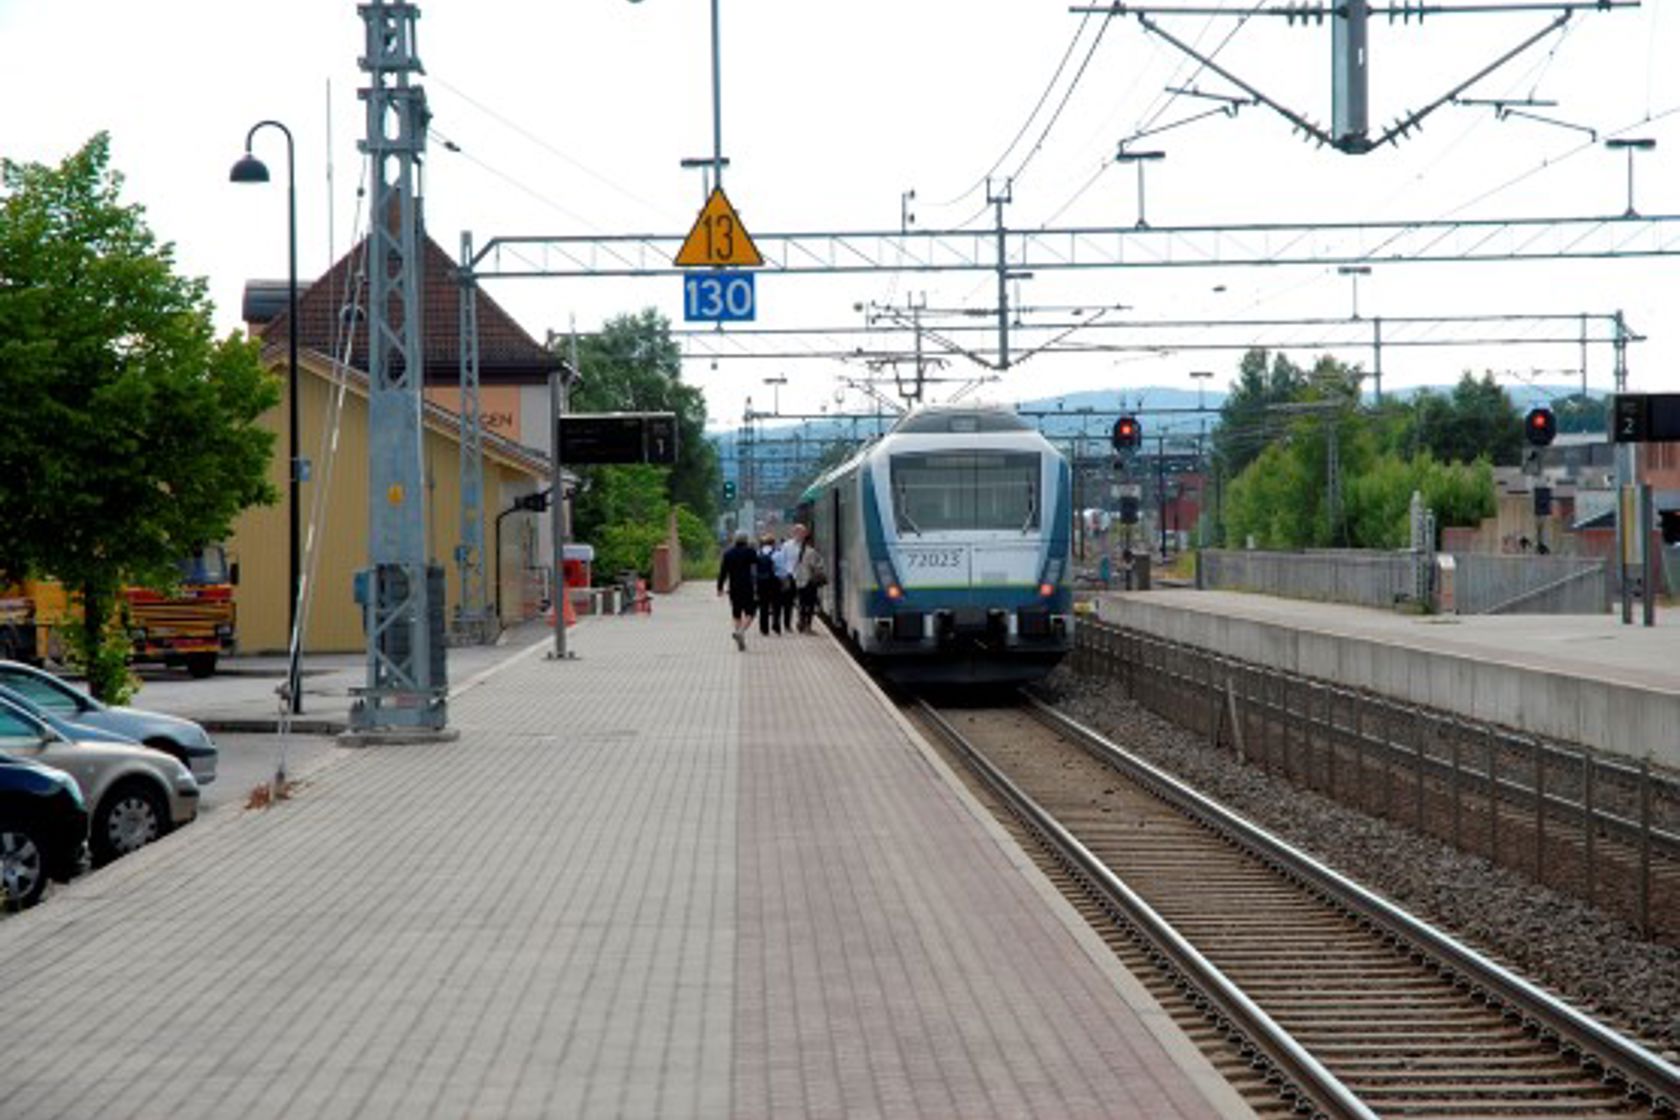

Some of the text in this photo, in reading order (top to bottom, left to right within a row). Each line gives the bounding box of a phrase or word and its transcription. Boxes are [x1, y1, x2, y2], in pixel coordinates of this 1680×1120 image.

[703, 214, 733, 261] 13
[687, 278, 751, 317] 130
[1622, 417, 1634, 434] 2
[656, 438, 665, 455] 1
